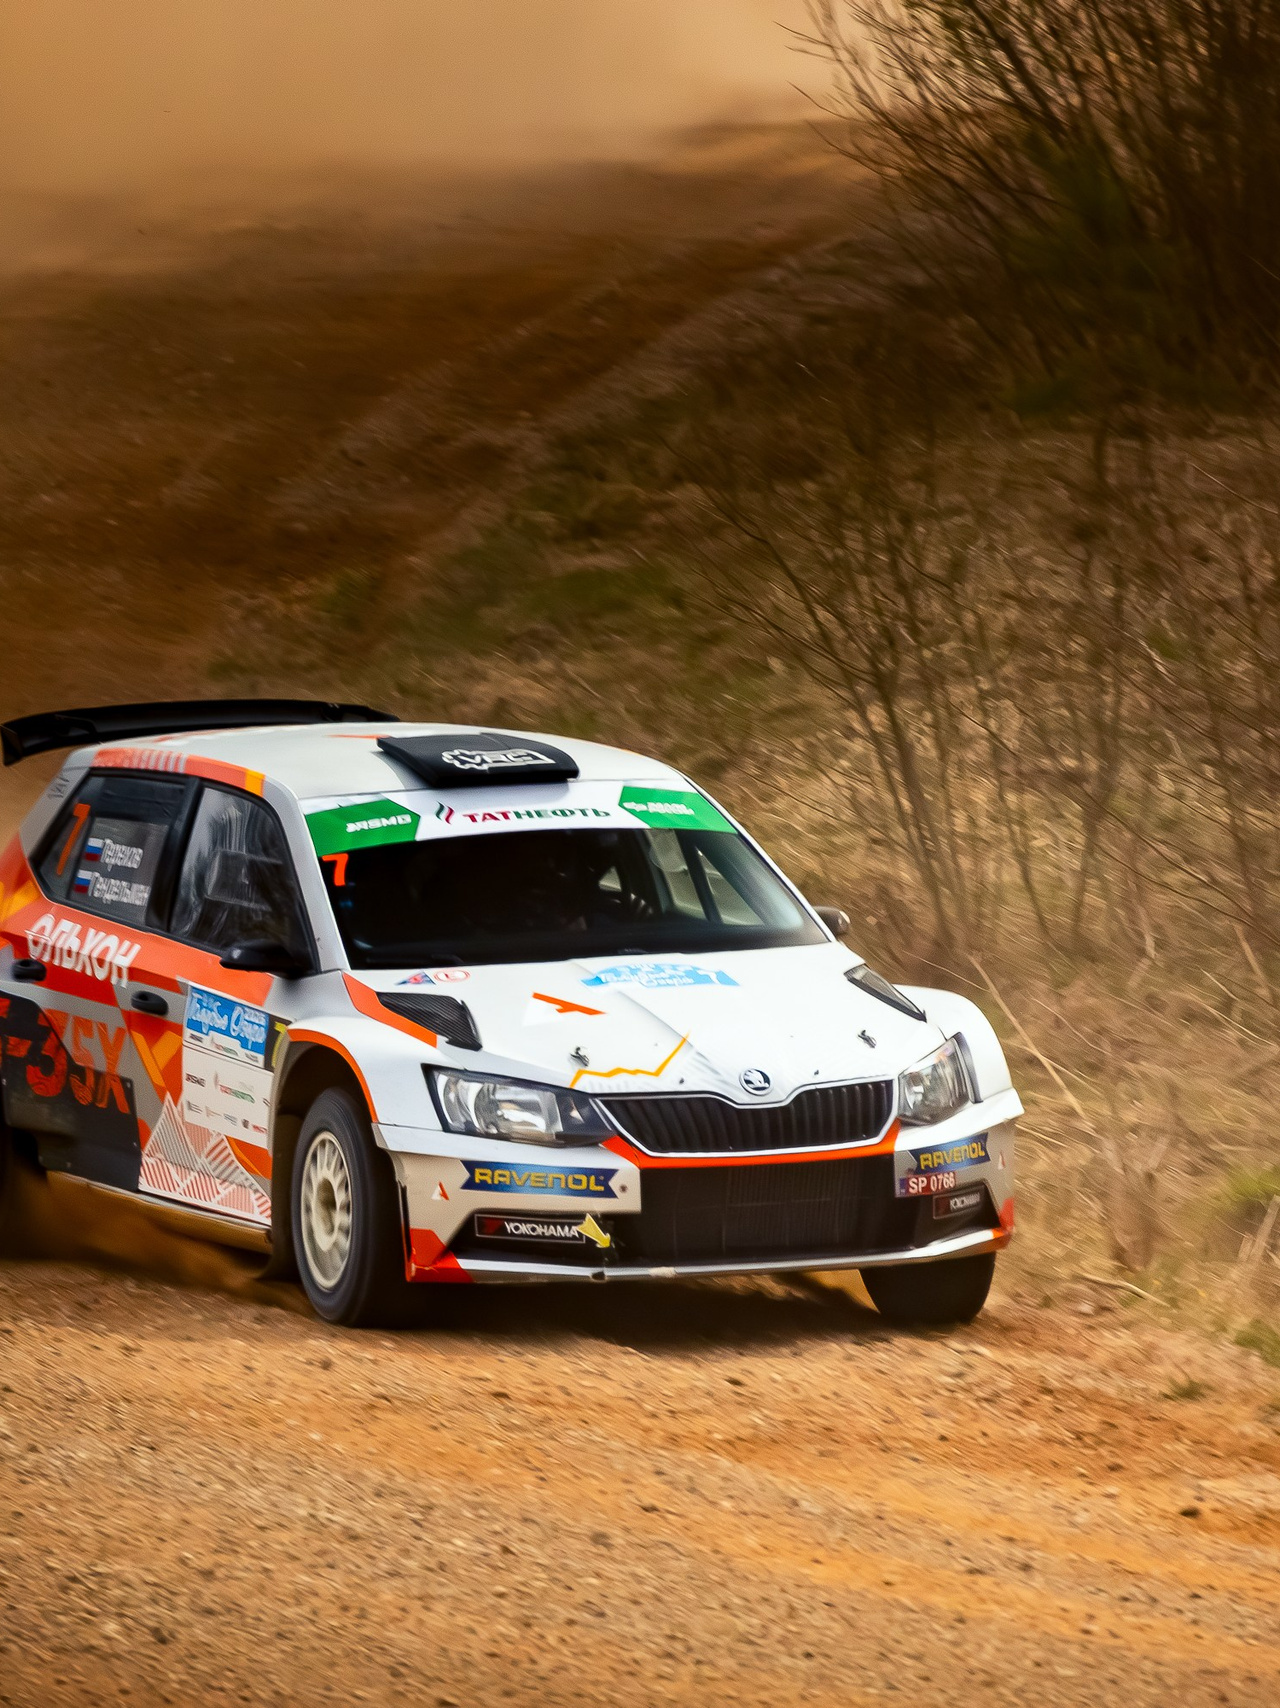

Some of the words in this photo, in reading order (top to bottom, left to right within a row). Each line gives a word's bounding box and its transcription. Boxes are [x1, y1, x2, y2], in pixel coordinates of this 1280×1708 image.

[462, 808, 611, 823] ТАТНЕФТЬ
[56, 803, 91, 876] 7
[321, 852, 349, 887] 7
[919, 1141, 986, 1170] RAVENOL
[474, 1167, 605, 1192] RAVENOL
[908, 1177, 928, 1194] SP
[504, 1221, 581, 1239] YOKOHAMA
